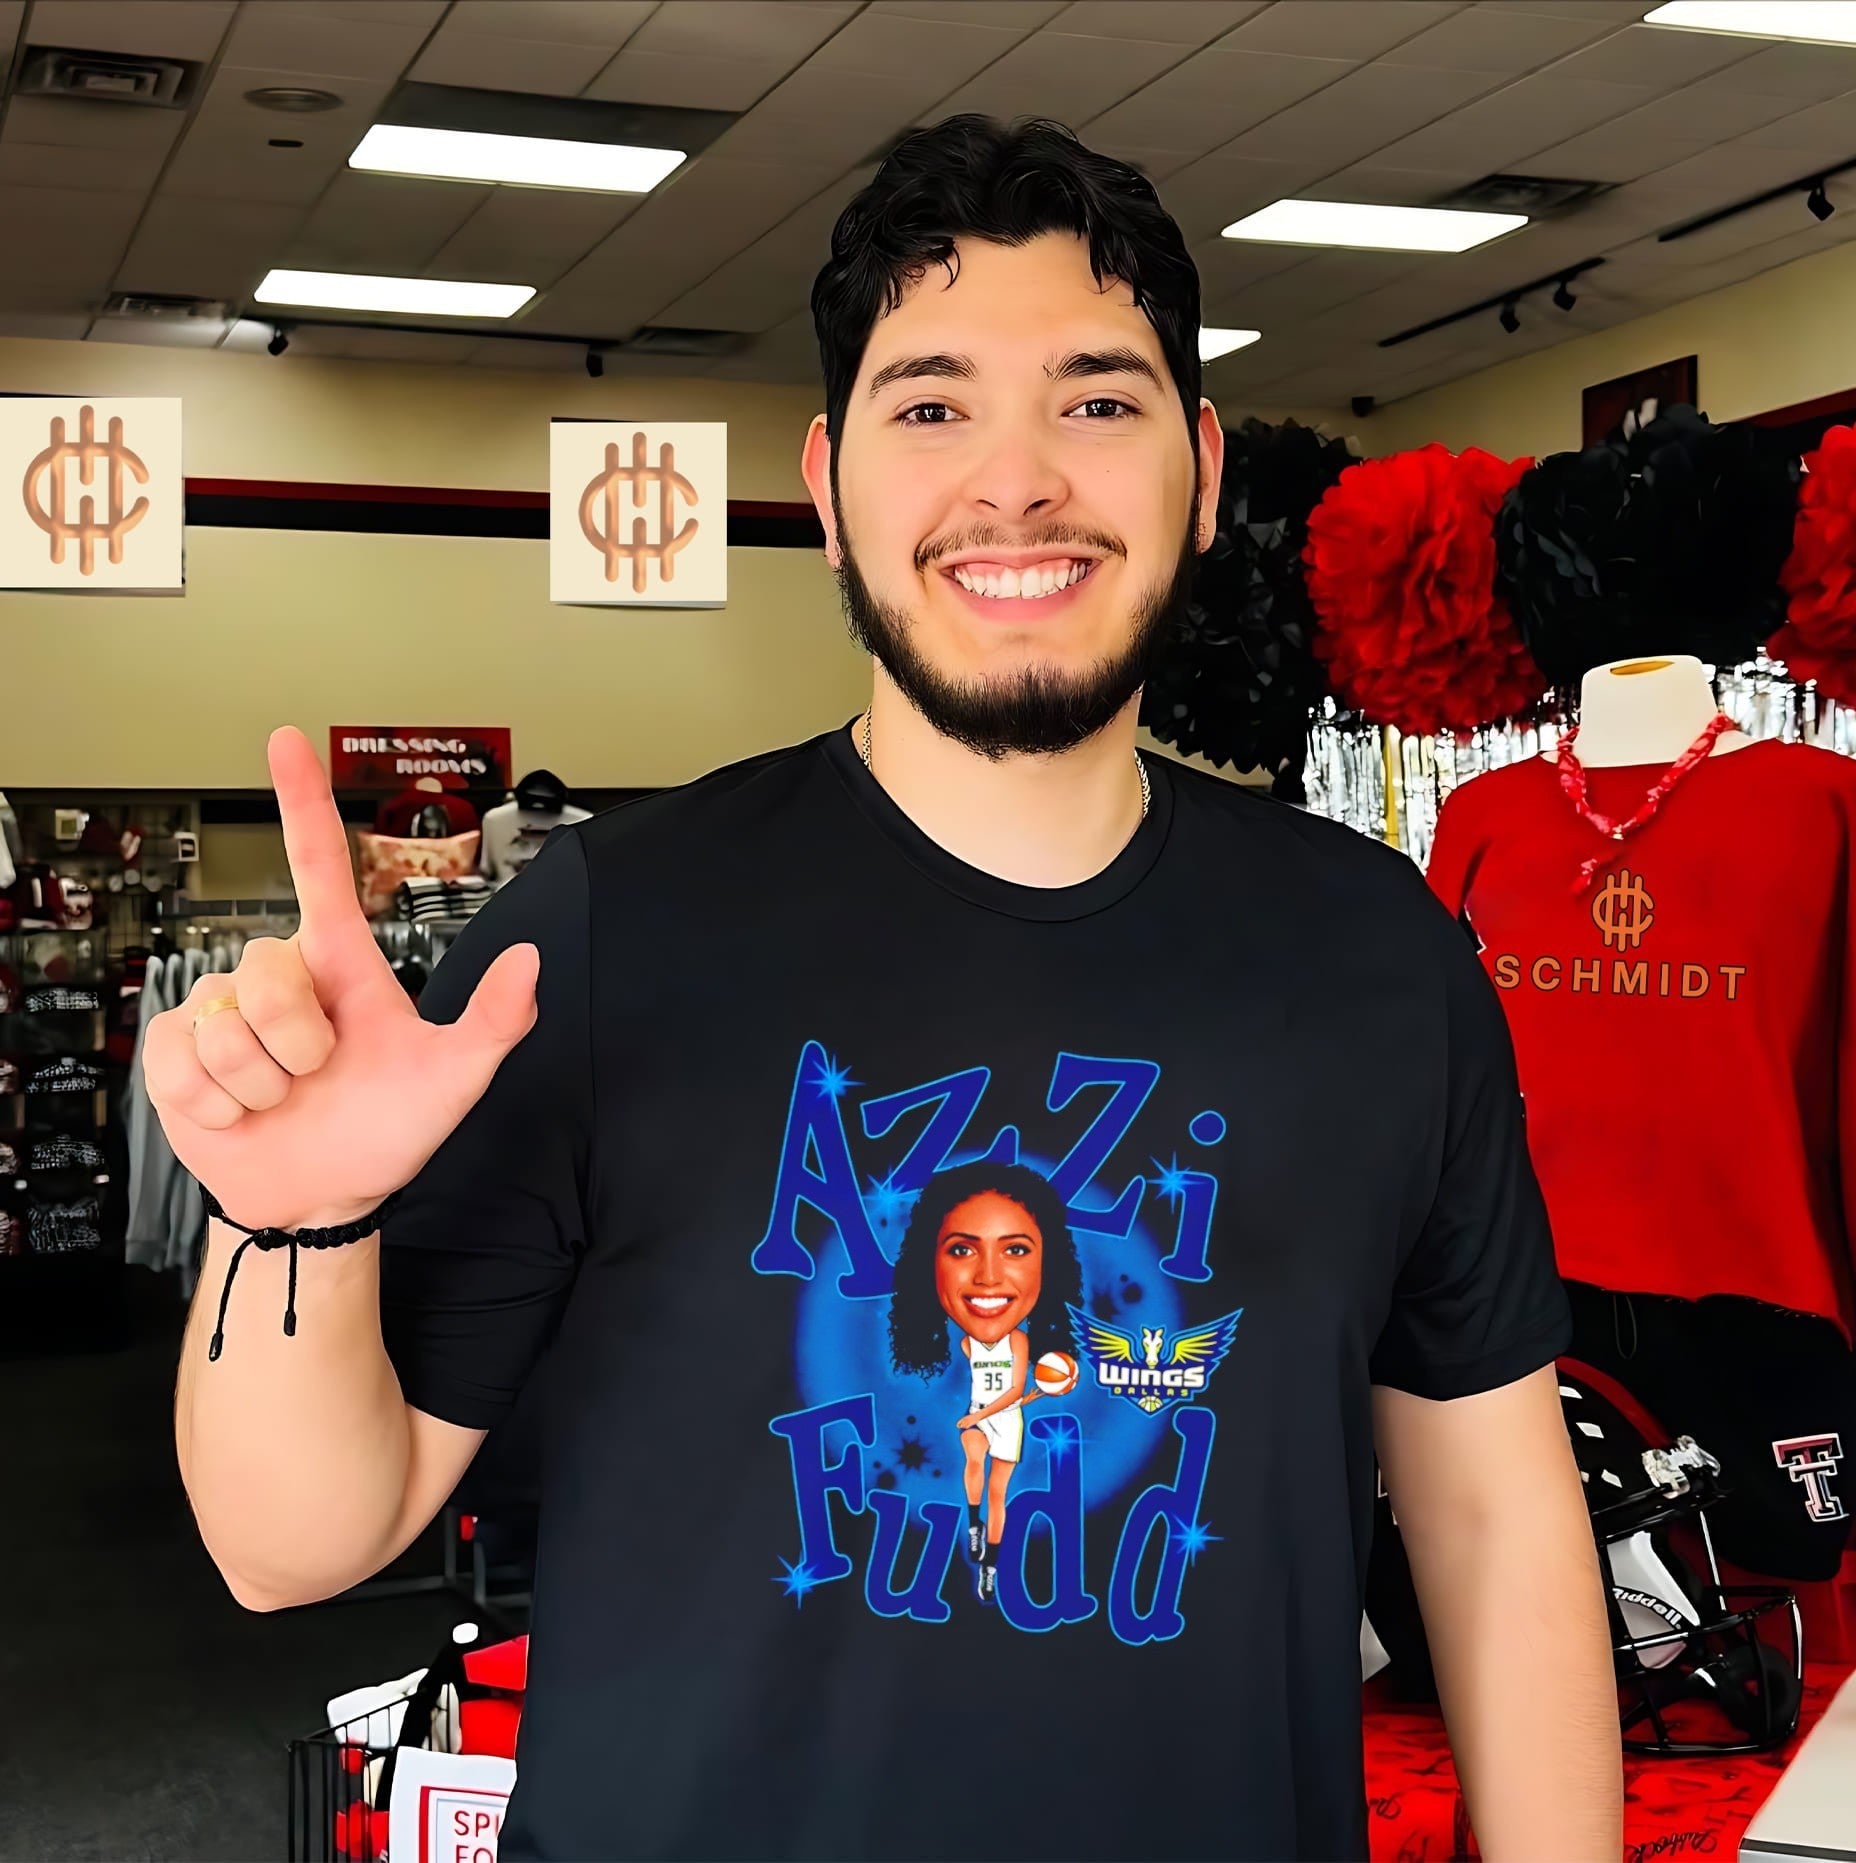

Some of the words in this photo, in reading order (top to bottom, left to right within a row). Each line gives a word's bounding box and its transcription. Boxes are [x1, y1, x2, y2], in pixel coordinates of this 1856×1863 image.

[342, 736, 467, 754] DRESSING
[395, 757, 488, 775] ROOMS
[1494, 953, 1747, 1001] SCHMIDT
[984, 1372, 1003, 1391] 35
[1112, 1385, 1190, 1397] DALLAS
[768, 1392, 1217, 1646] Fudd
